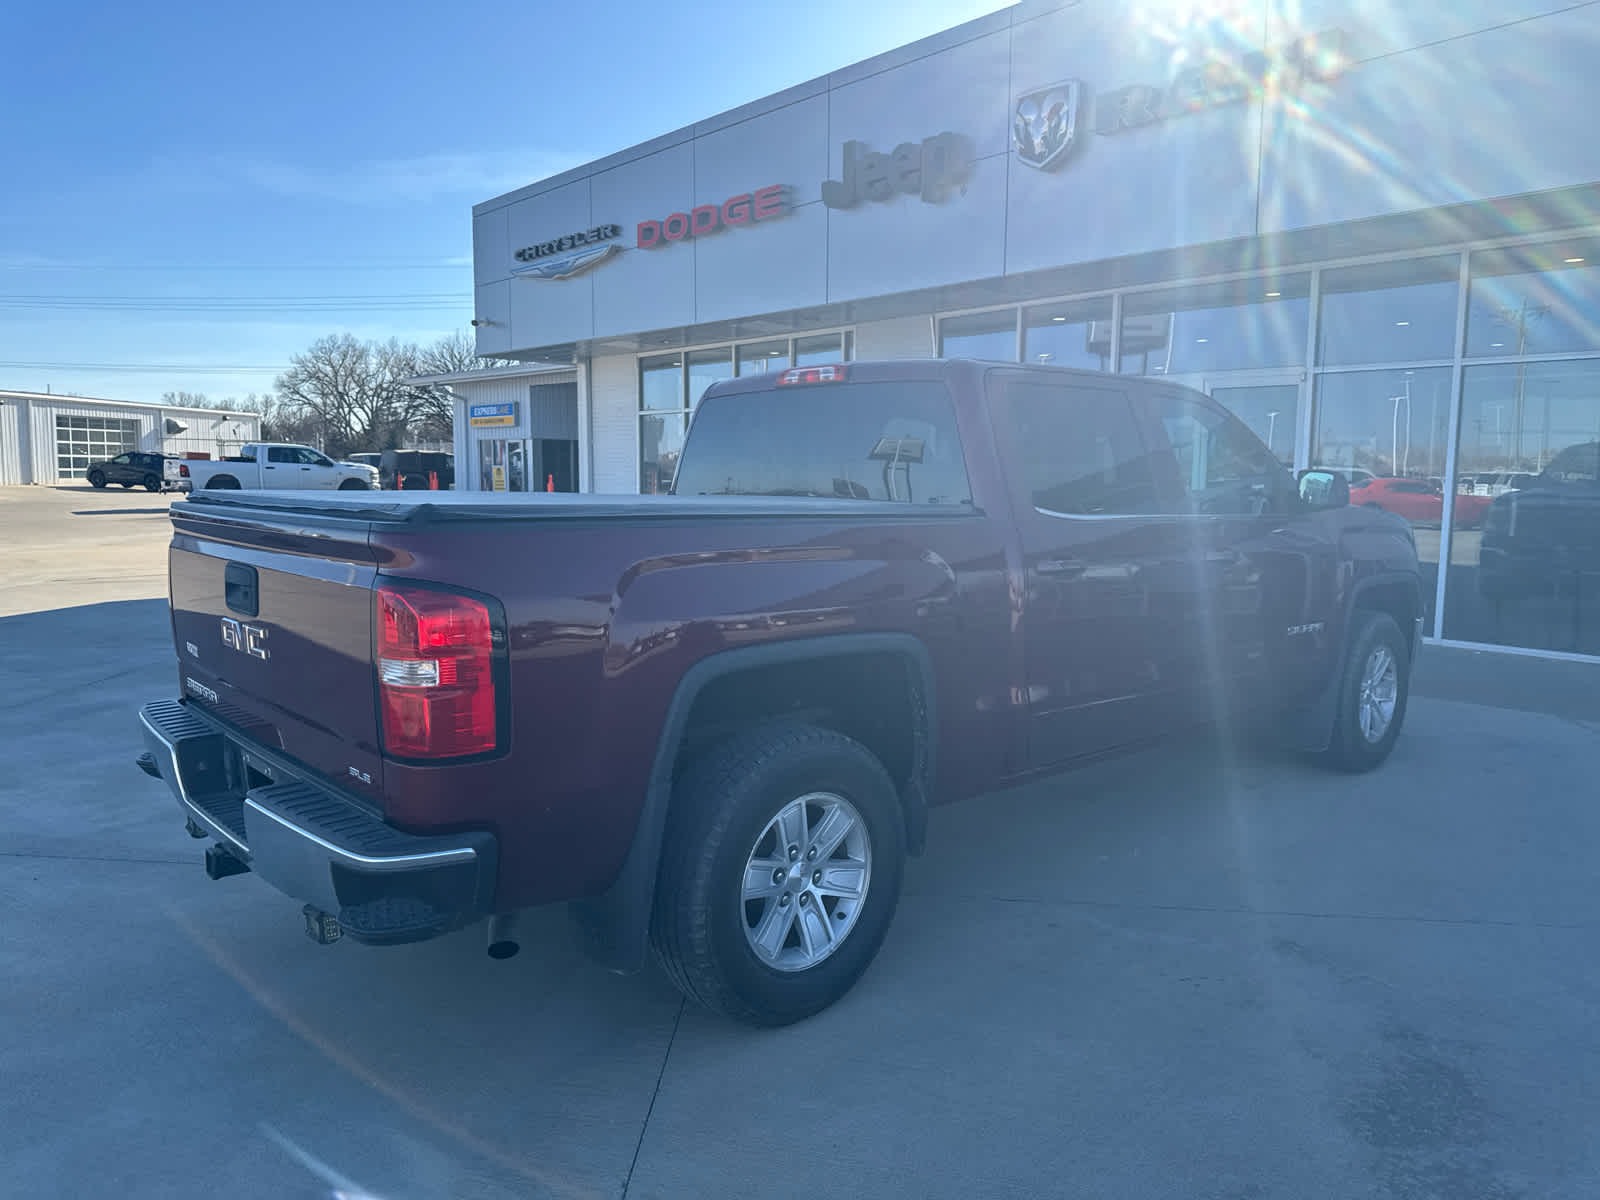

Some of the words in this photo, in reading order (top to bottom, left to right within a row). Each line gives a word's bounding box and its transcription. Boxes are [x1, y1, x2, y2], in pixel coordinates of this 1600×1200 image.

[822, 131, 975, 211] Jeep
[514, 224, 622, 263] CHRYSLER
[637, 184, 792, 250] DODGE
[221, 617, 269, 660] GMC
